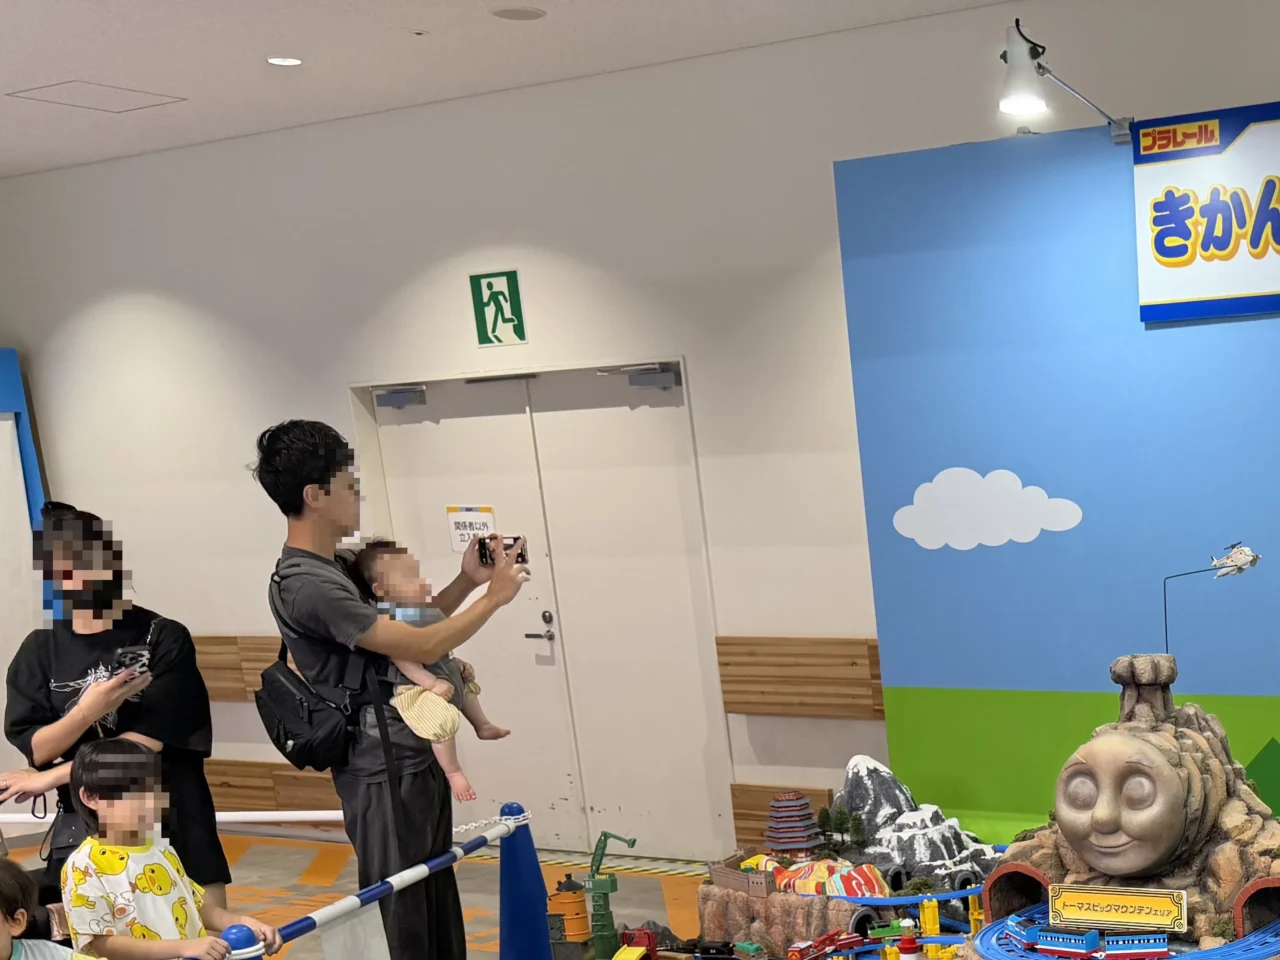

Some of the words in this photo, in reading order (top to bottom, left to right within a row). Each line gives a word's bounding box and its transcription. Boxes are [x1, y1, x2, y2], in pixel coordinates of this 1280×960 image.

[1141, 123, 1216, 153] プラレール
[453, 521, 489, 531] 関係者以外
[1062, 901, 1173, 917] トーマスビッグマウンテンエリア
